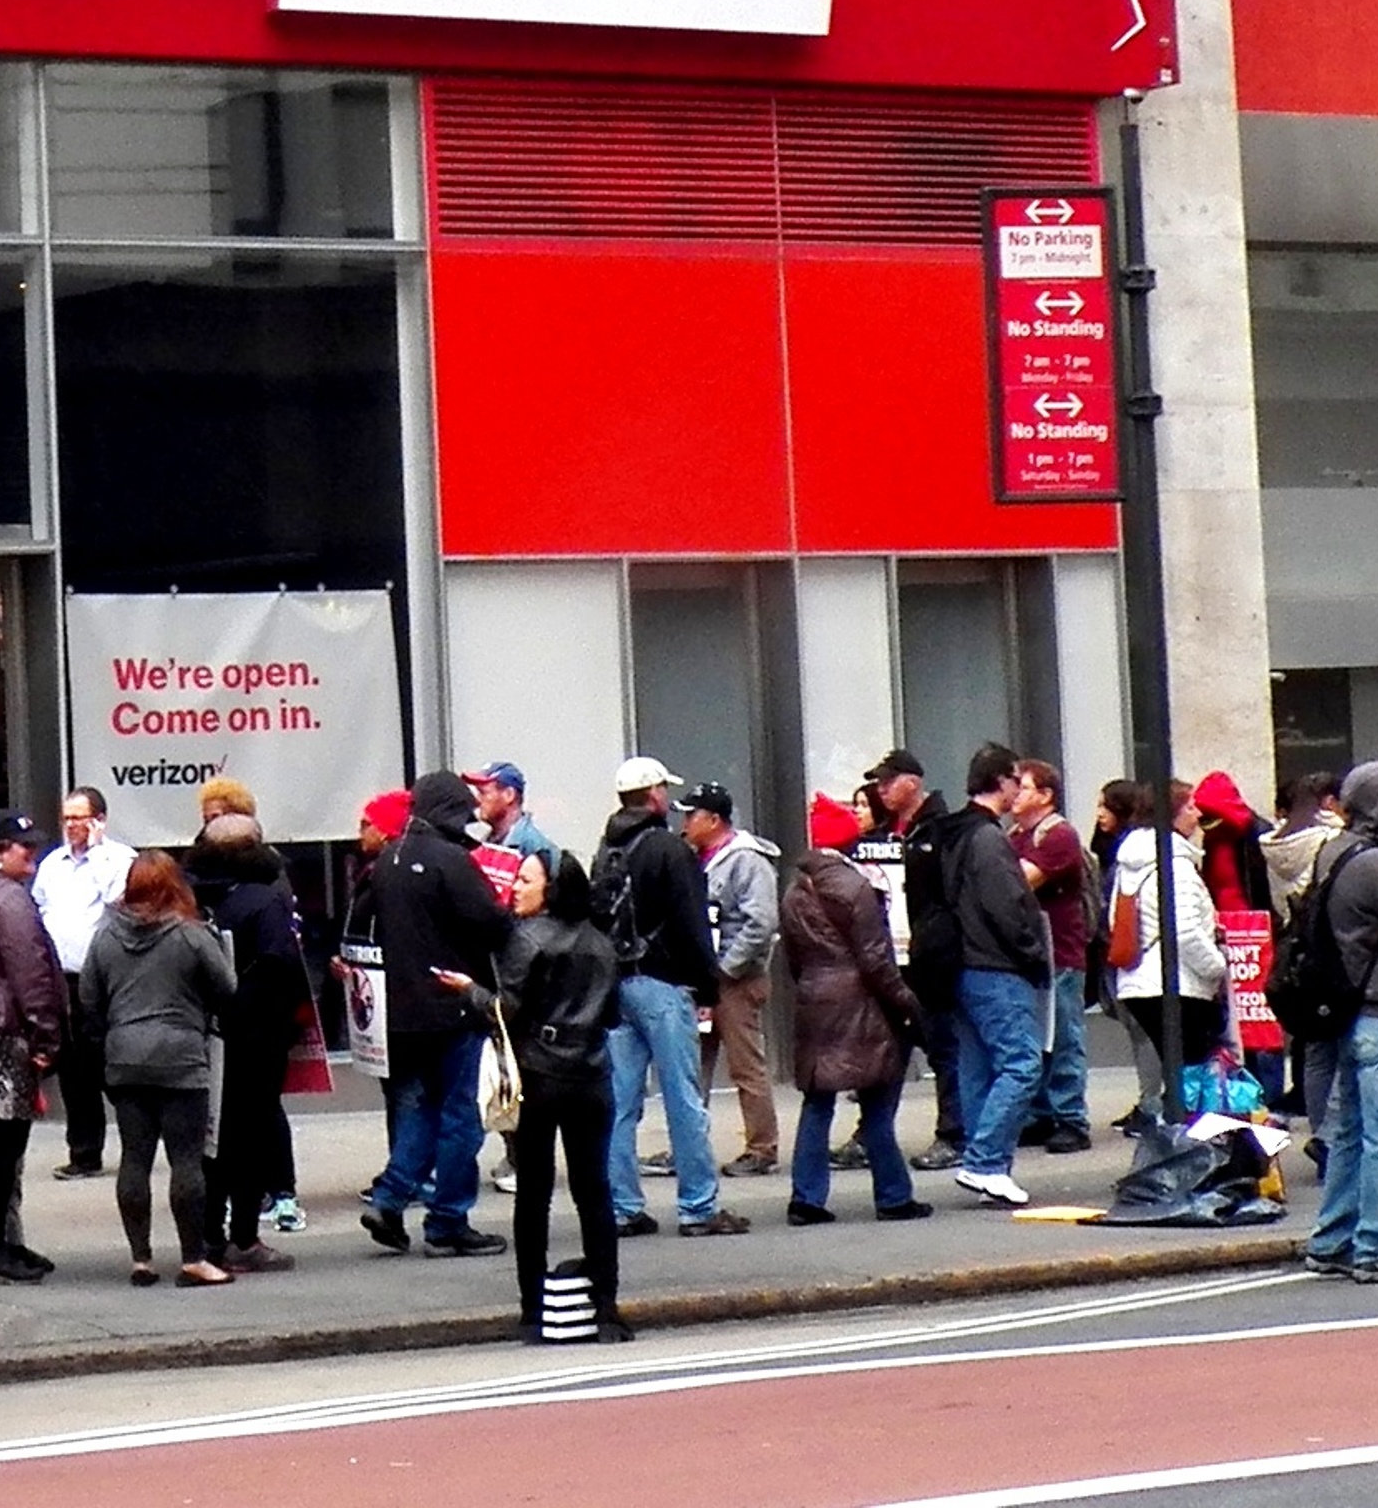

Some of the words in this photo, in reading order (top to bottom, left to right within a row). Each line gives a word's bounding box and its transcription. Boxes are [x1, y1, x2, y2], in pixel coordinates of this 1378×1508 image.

[1008, 231, 1030, 247] No
[1034, 230, 1093, 250] Parking
[1007, 320, 1031, 337] No
[1033, 318, 1105, 340] Standing
[1010, 422, 1035, 440] No
[1036, 420, 1109, 443] Standing
[113, 657, 214, 691] We're
[221, 661, 320, 694] open.
[111, 701, 221, 735] Come
[227, 706, 271, 732] on
[279, 698, 321, 730] in.
[111, 758, 216, 786] verizon
[857, 842, 903, 860] STRIKE
